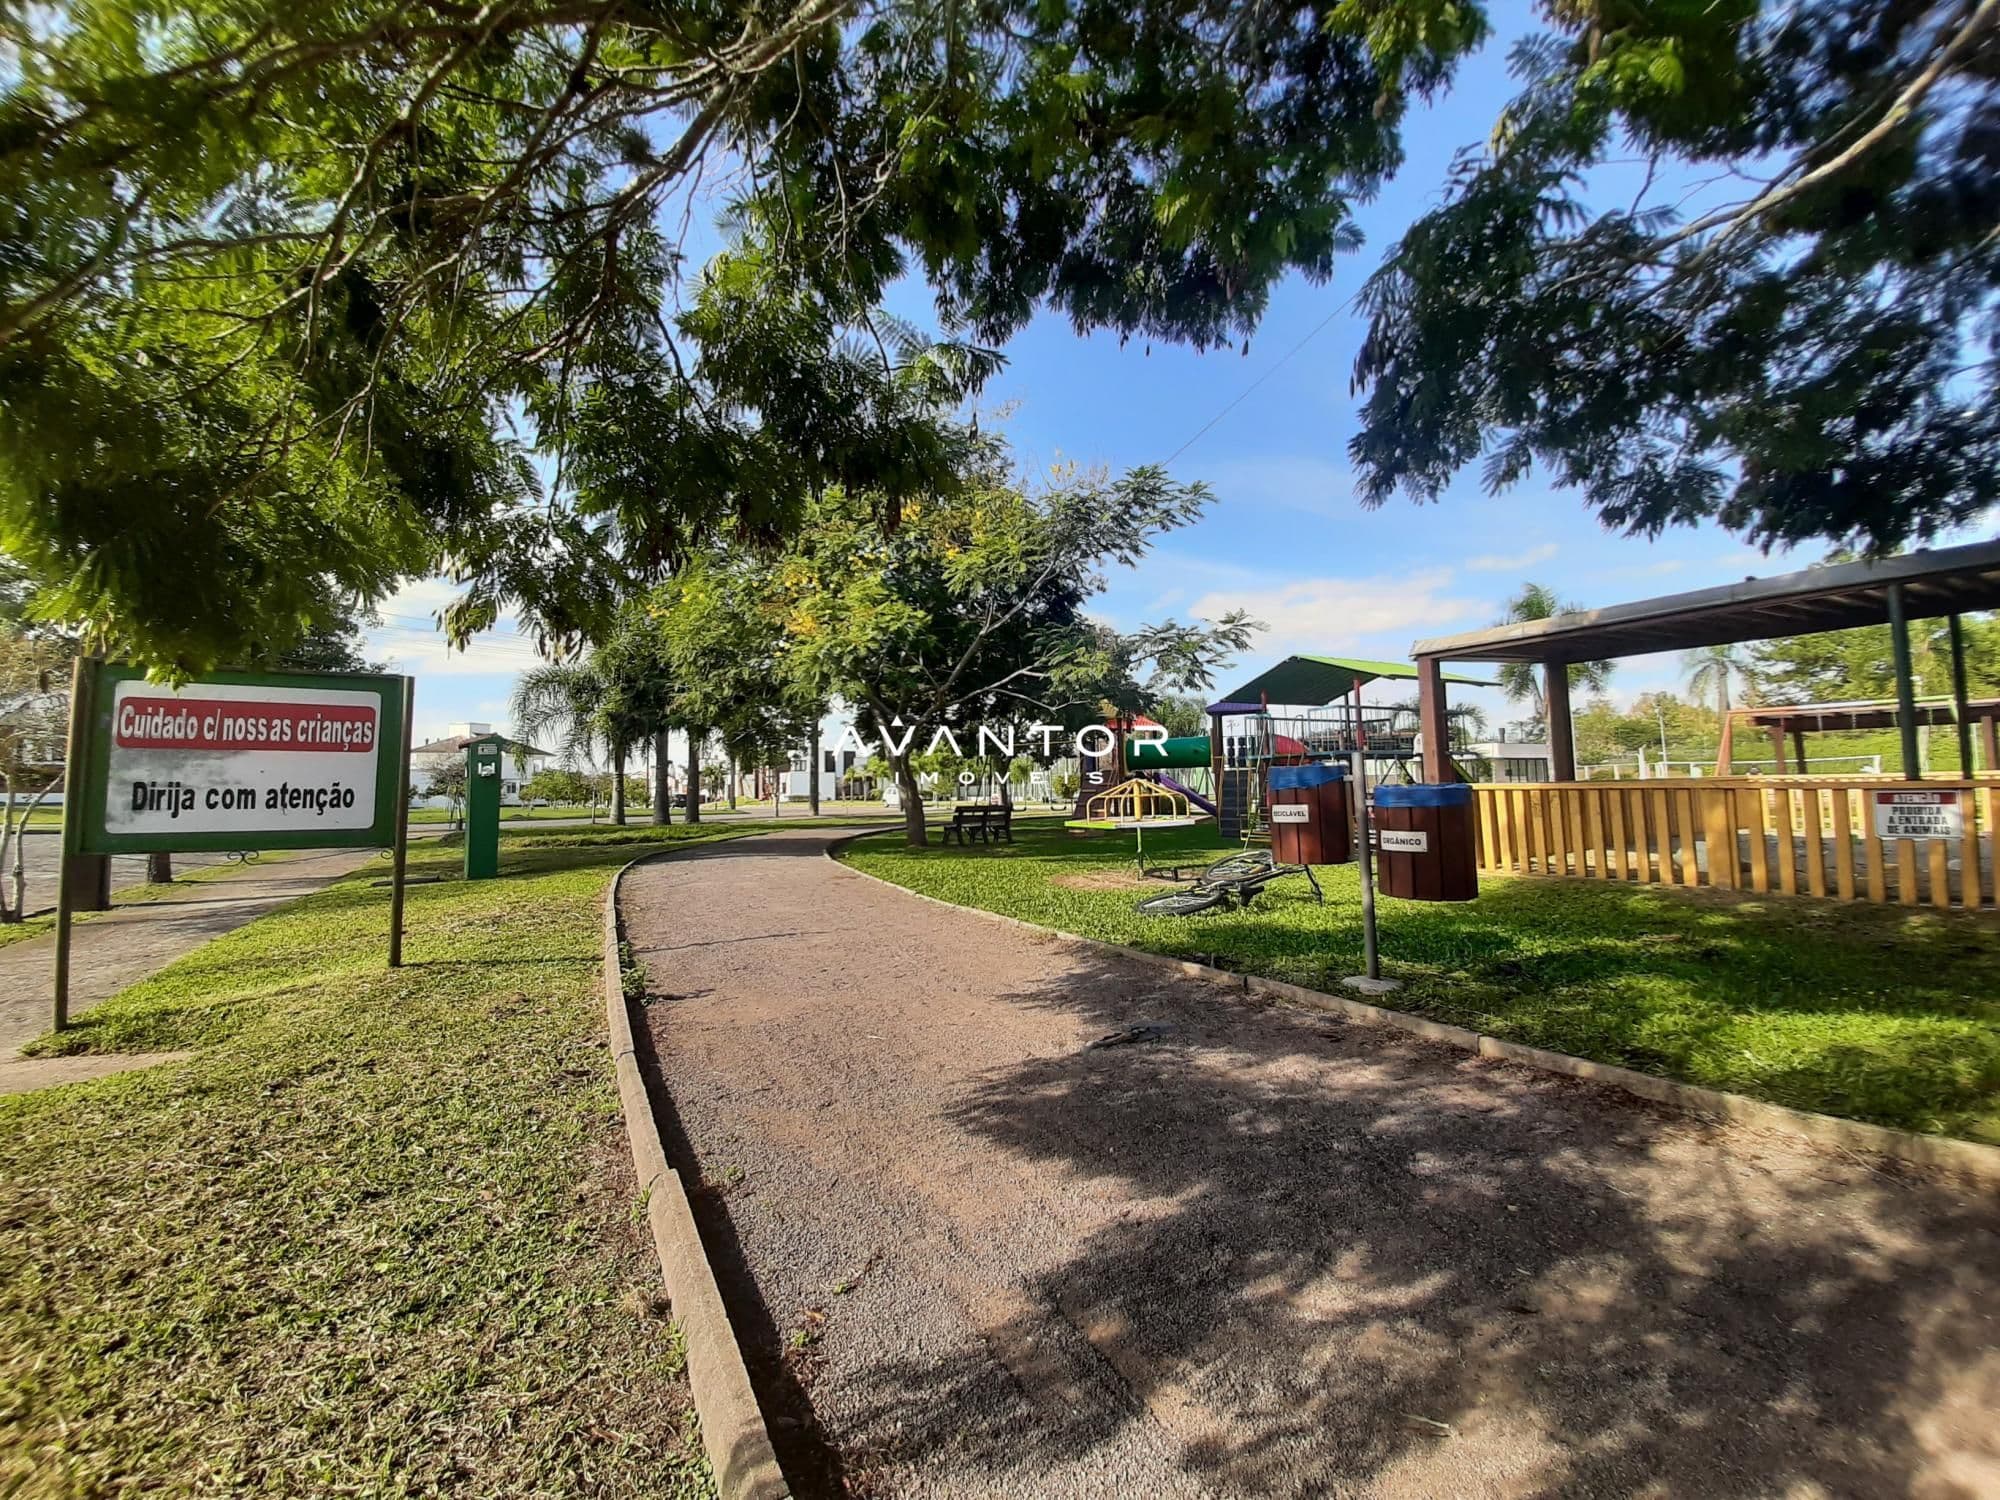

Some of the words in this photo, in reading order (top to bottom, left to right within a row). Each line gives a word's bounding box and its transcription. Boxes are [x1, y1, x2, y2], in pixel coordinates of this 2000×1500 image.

[120, 705, 198, 740] Cuidado
[297, 712, 373, 751] crianças
[131, 781, 195, 819] Dirija
[205, 788, 256, 810] com
[265, 781, 355, 815] atenção
[1888, 816, 1895, 825] A
[1383, 835, 1422, 846] ORGÂNICO
